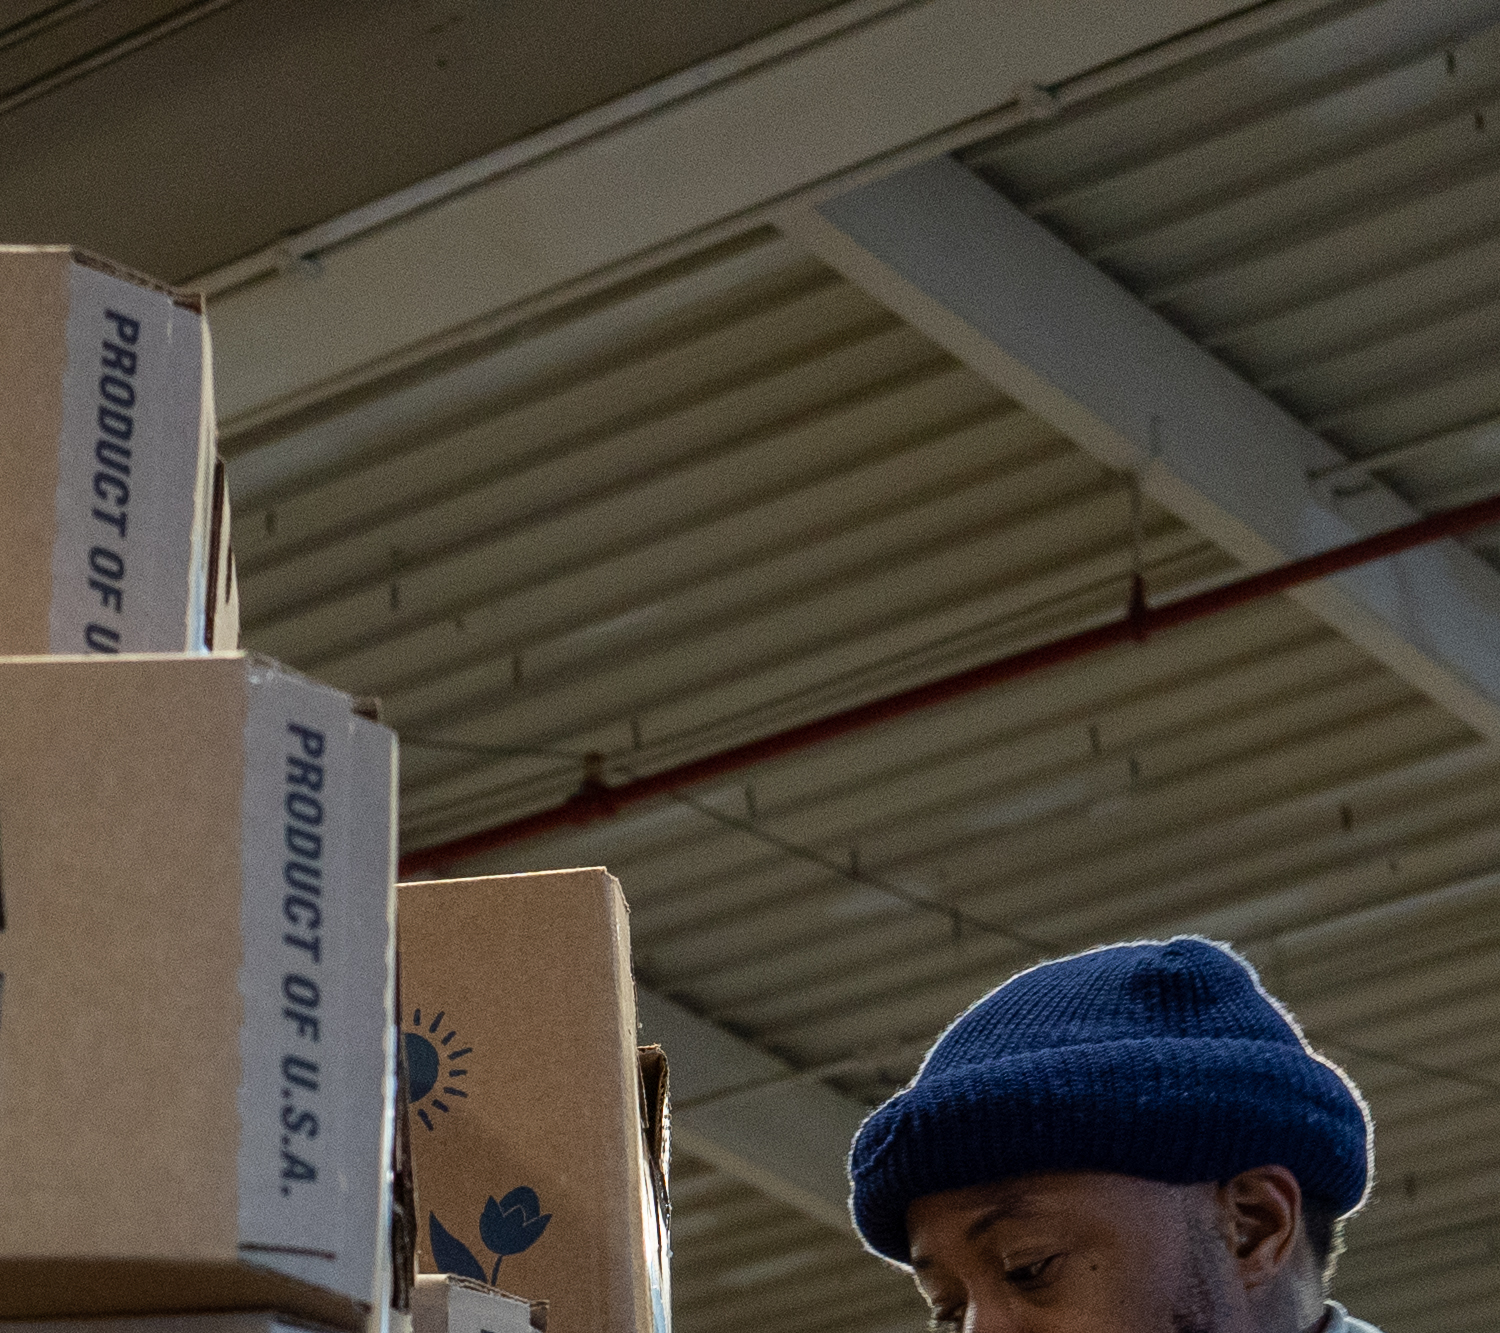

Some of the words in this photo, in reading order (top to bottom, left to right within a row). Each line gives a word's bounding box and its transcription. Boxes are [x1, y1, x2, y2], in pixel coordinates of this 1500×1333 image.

[90, 308, 141, 539] PRODUCT
[87, 546, 126, 614] OF
[281, 721, 326, 965] PRODUCT
[281, 972, 321, 1043] OF
[279, 1052, 321, 1198] U.S.A.
